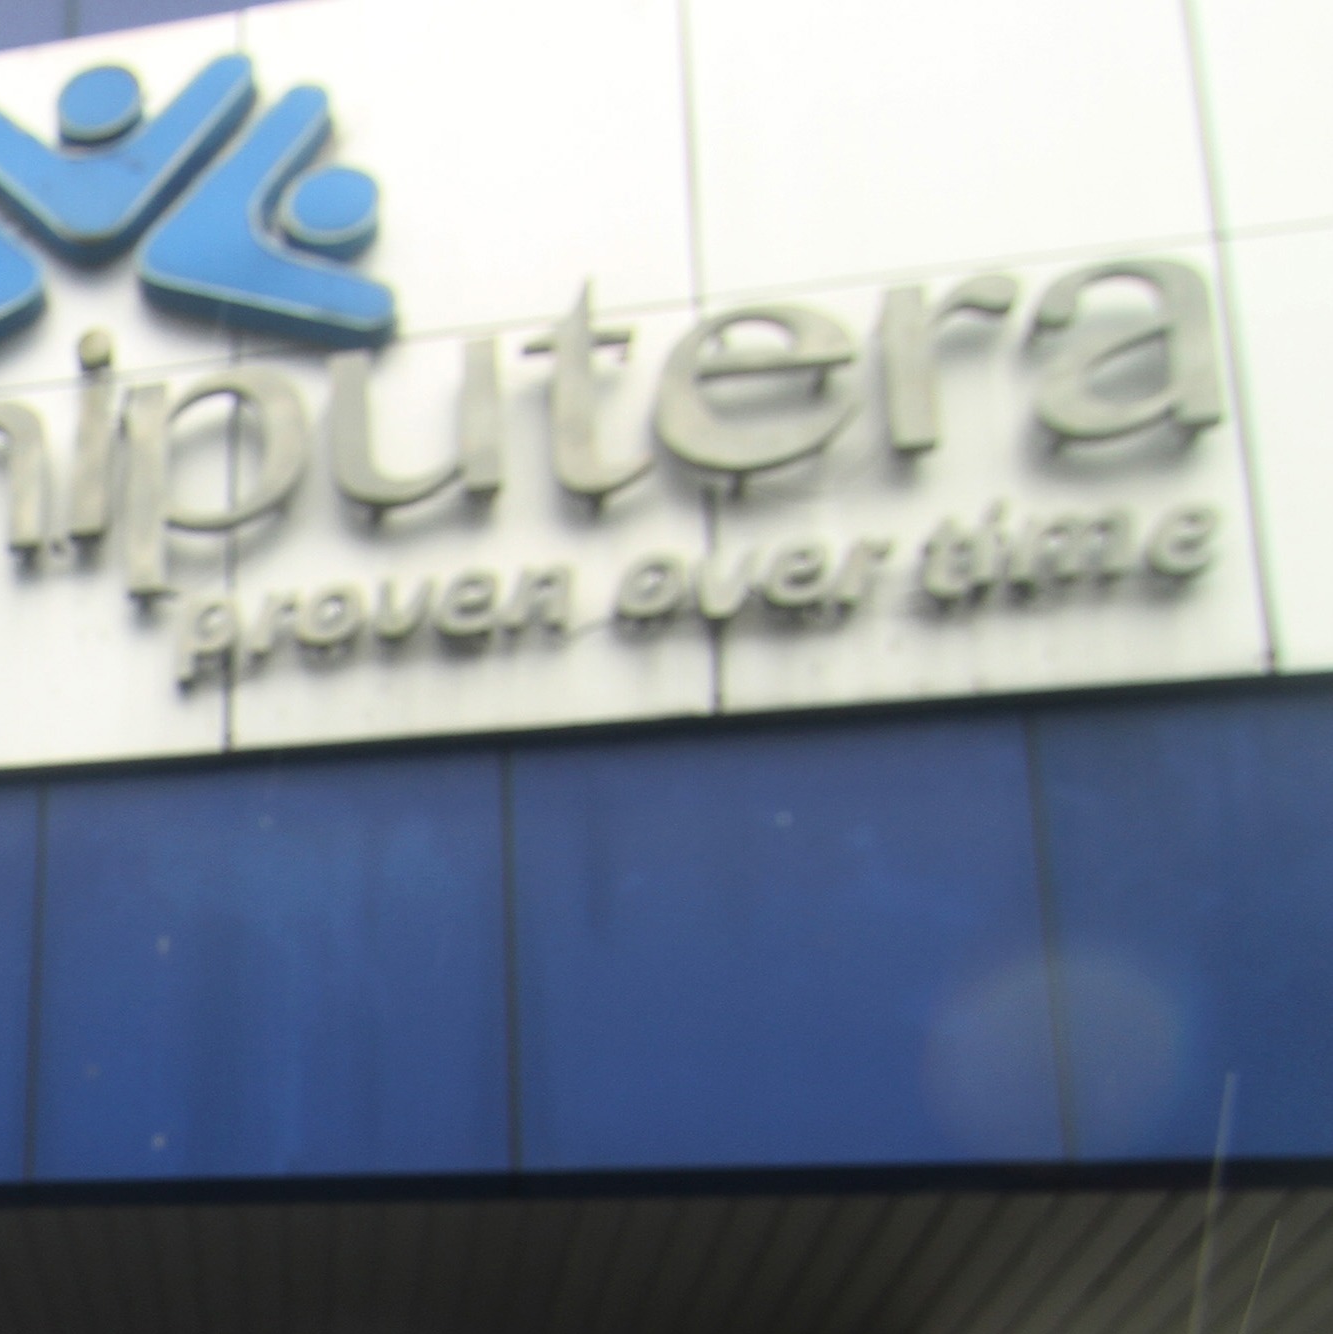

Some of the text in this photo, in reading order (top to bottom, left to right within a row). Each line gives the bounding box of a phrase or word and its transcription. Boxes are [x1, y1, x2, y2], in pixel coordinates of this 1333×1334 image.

[177, 499, 1220, 687] proven over time
